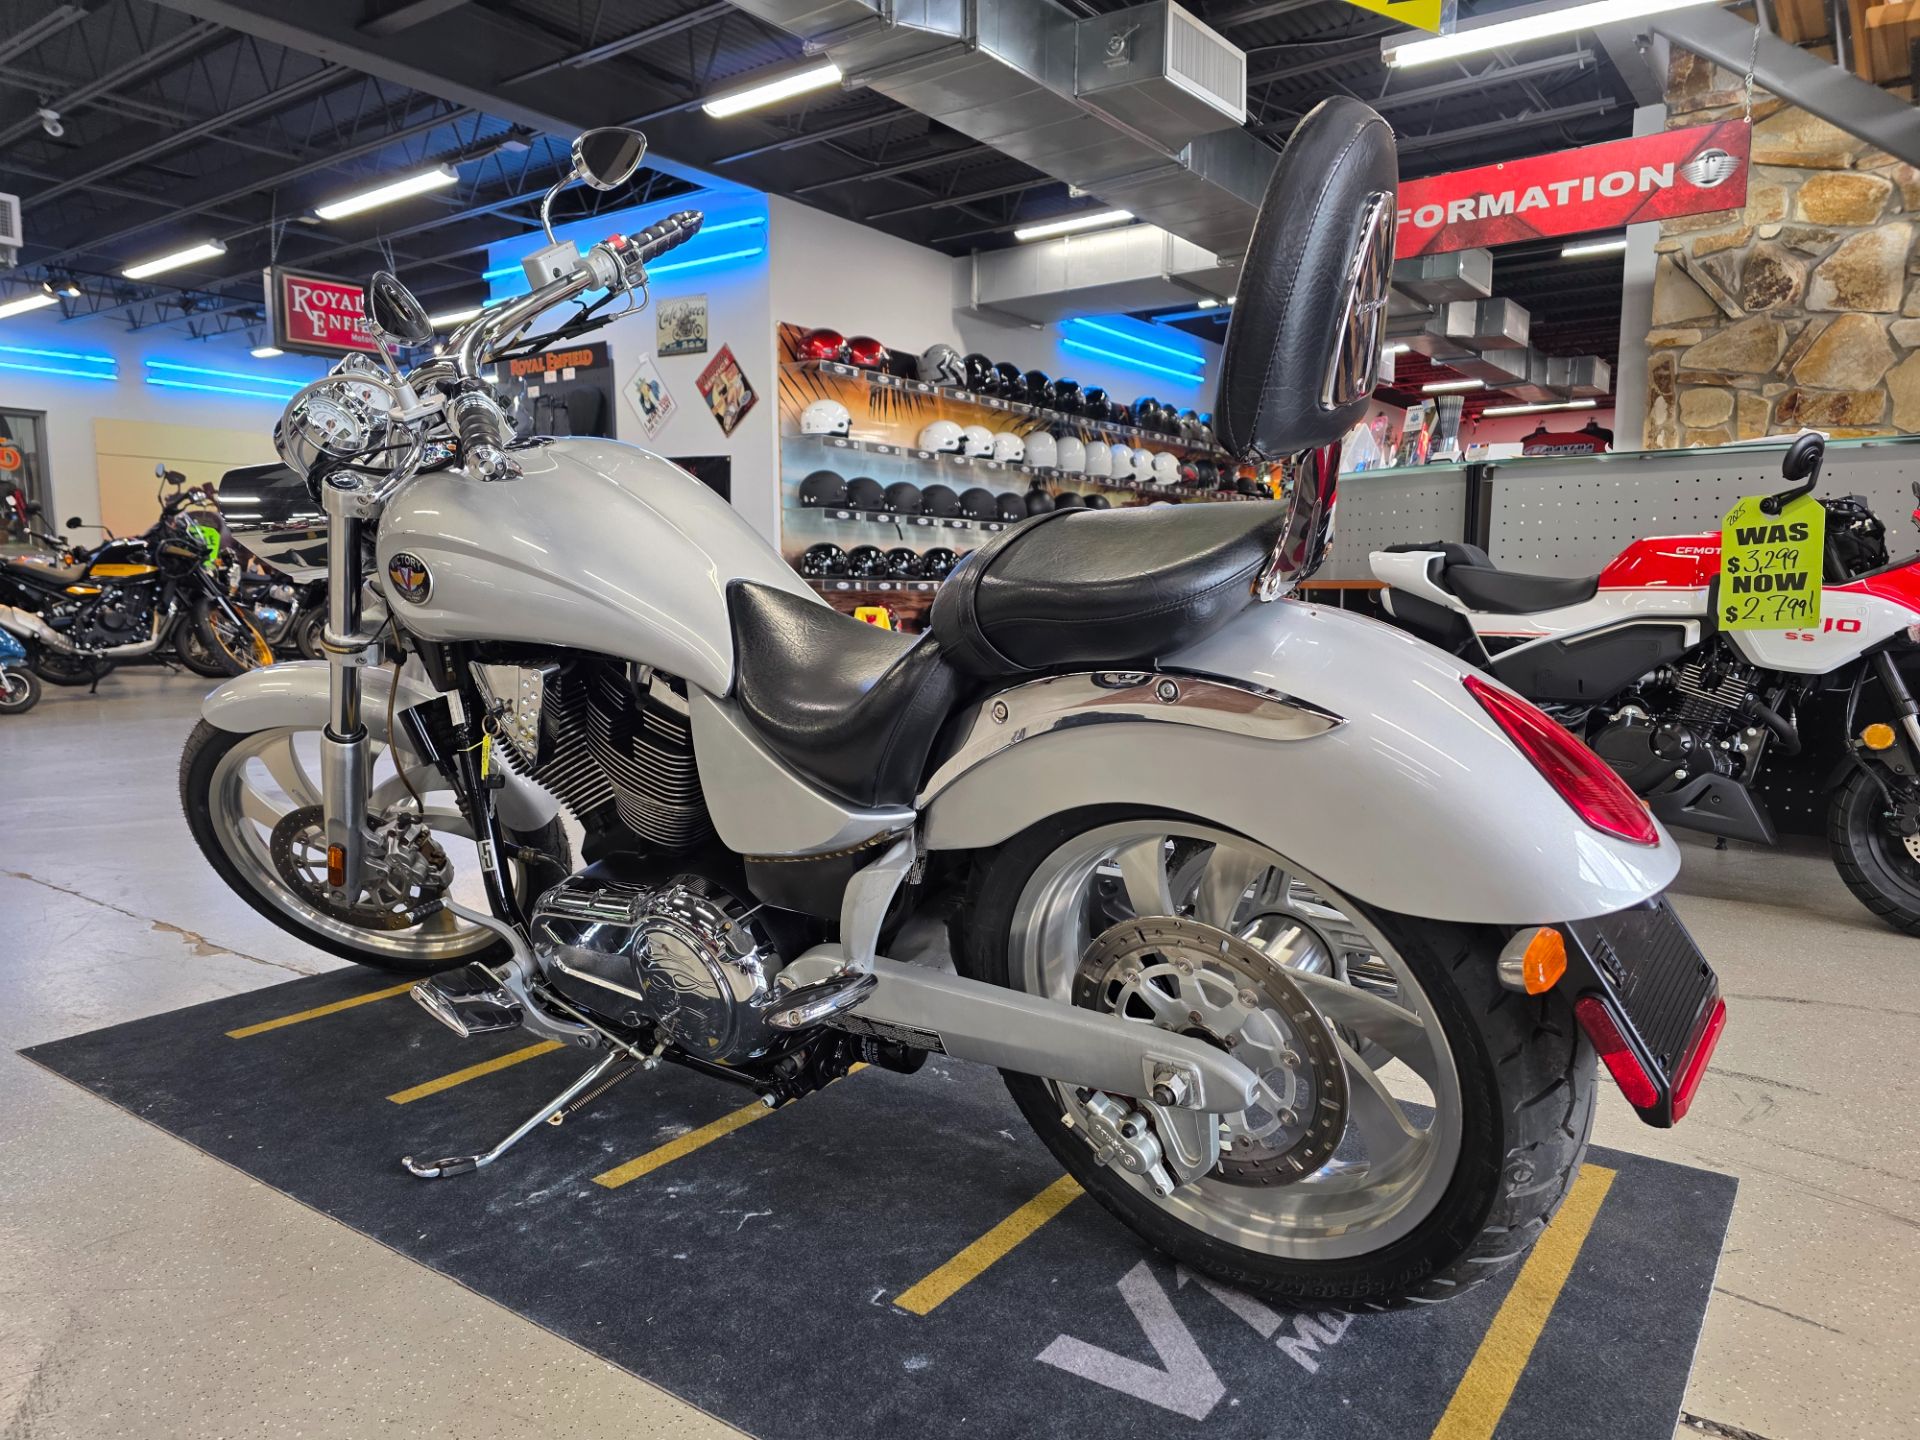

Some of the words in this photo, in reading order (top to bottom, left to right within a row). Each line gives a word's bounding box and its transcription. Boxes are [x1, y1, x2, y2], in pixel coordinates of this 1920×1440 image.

[291, 285, 365, 320] ROYAL
[510, 358, 546, 377] ROYAL
[546, 349, 594, 372] ENFIELD
[1735, 522, 1809, 547] WAS
[1731, 572, 1808, 594] NOW
